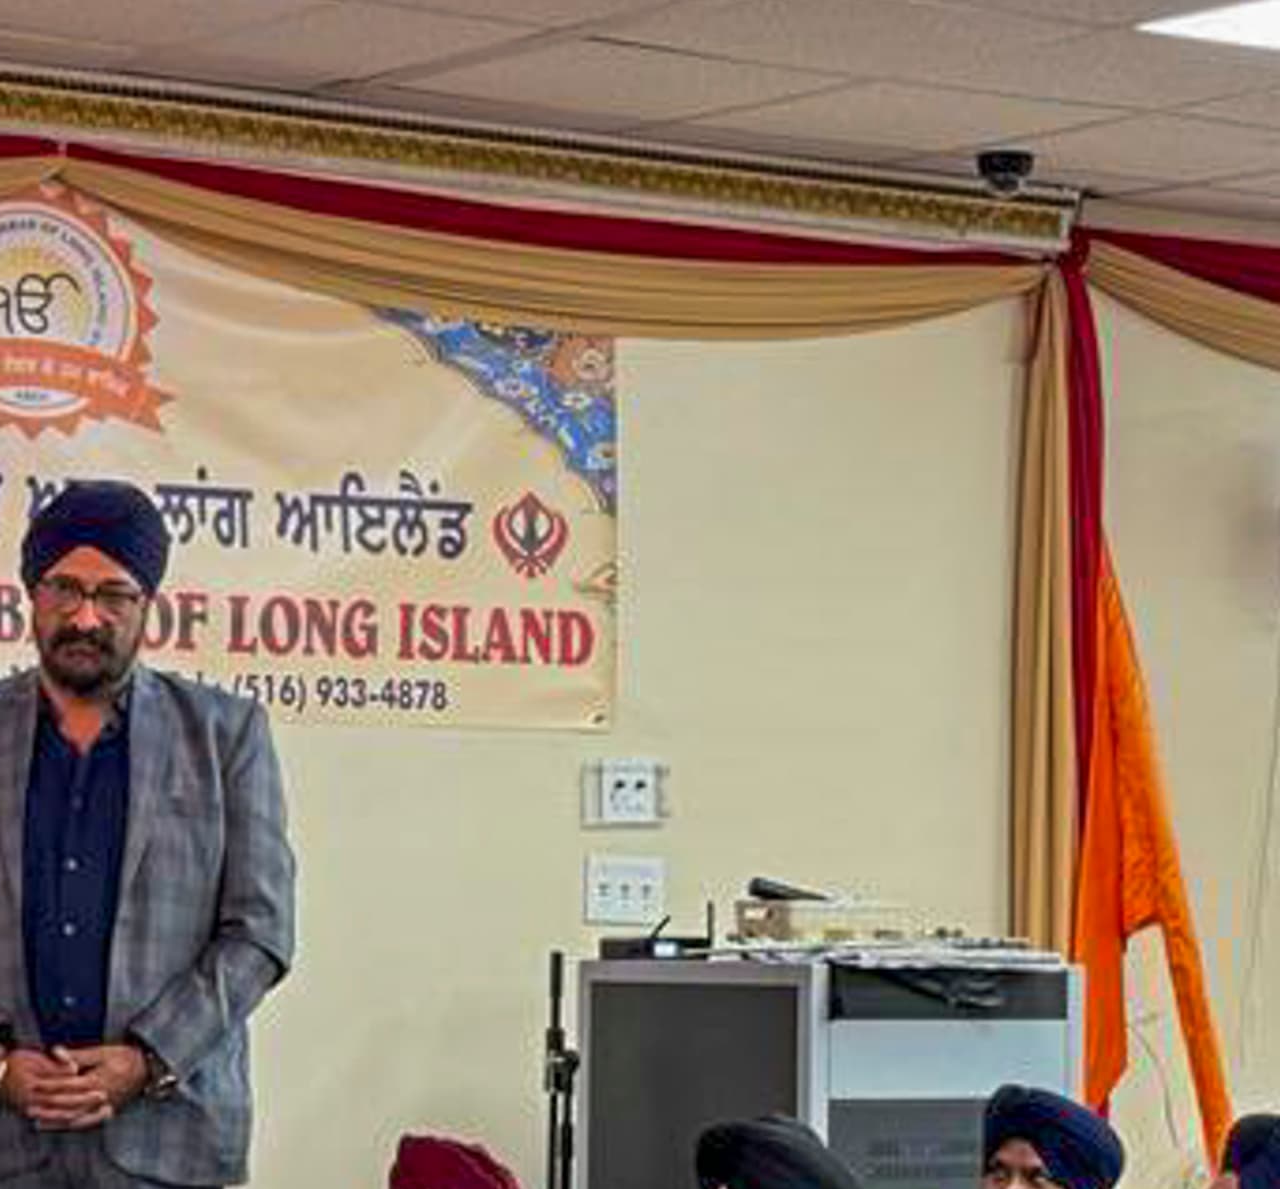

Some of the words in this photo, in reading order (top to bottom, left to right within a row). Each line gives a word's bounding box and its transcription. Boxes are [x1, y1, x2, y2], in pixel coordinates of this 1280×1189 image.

[156, 466, 253, 549] ਲਾਂਗ
[275, 469, 473, 559] ਆਇਲੈਂਡ
[141, 593, 208, 652] OF
[226, 596, 379, 658] LONG
[397, 602, 596, 666] ISLAND
[234, 674, 308, 712] (516)
[315, 675, 448, 710] 933-4878
